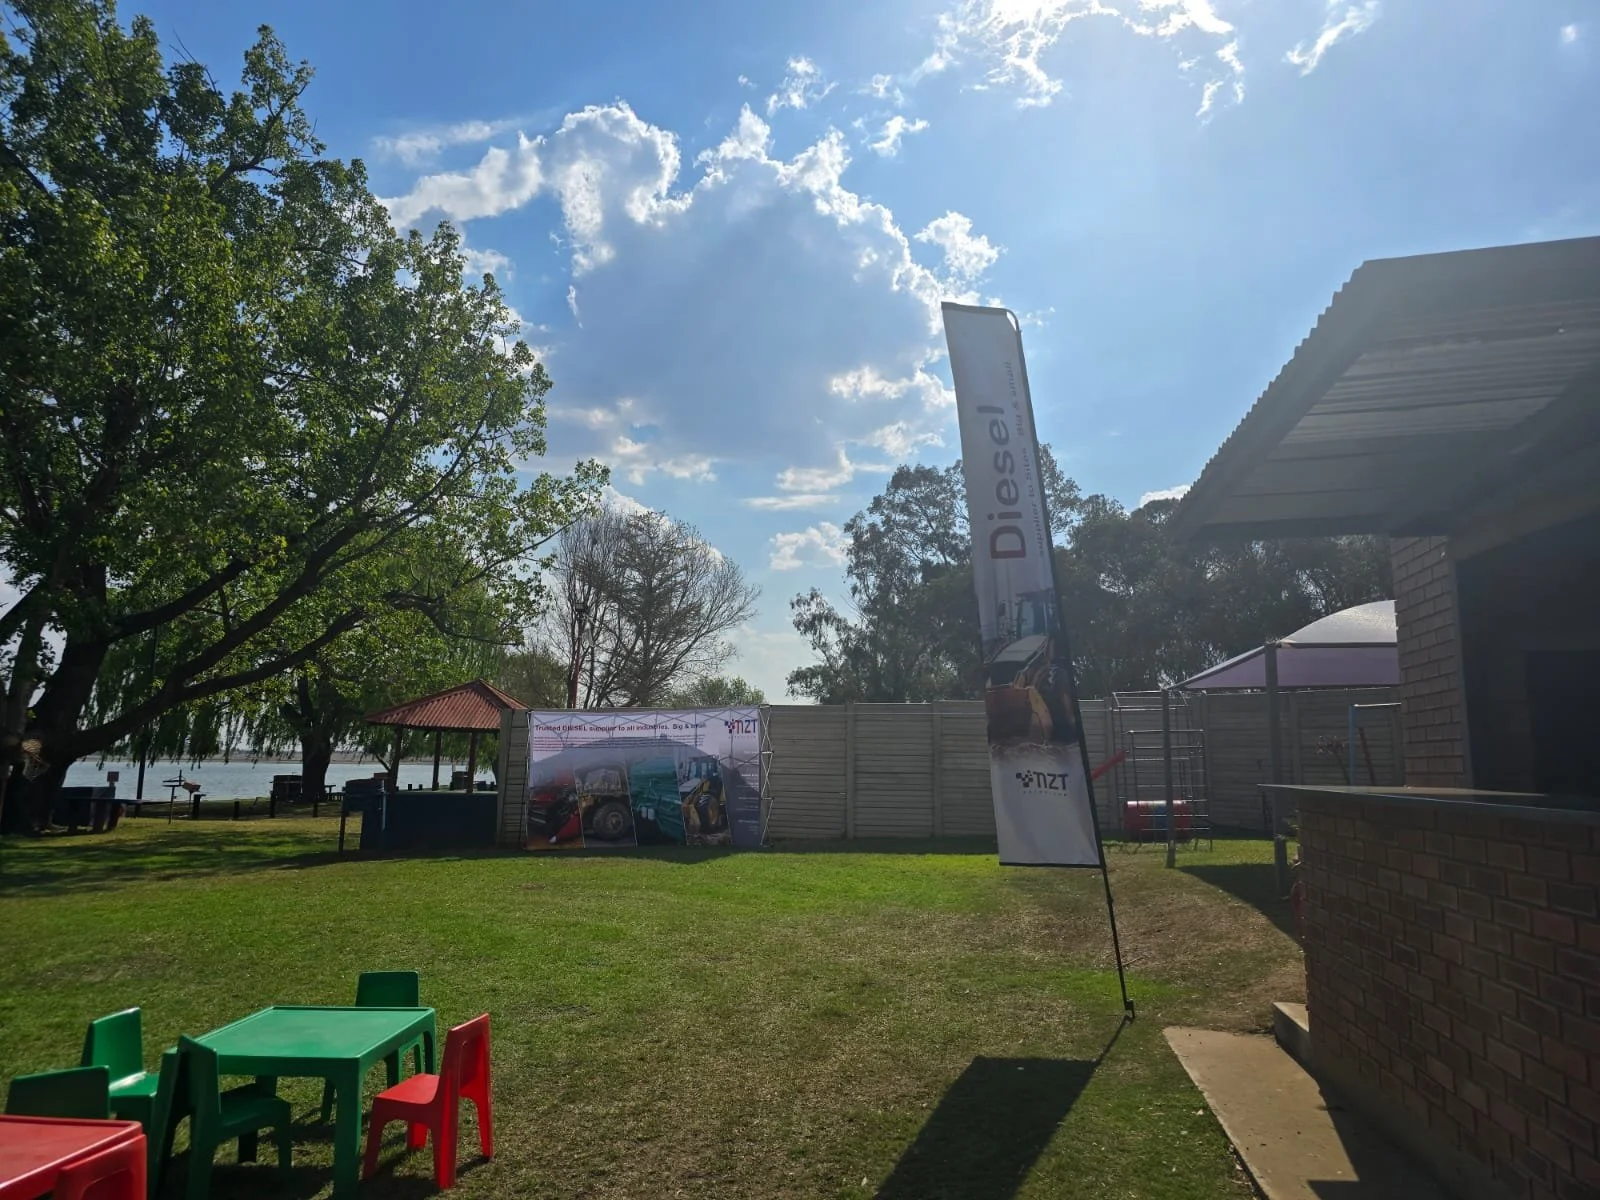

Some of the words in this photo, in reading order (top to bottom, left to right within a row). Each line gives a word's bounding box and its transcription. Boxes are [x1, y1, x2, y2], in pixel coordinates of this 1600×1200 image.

[976, 405, 1027, 560] Diesel
[1032, 503, 1044, 557] supplier
[618, 724, 626, 732] to
